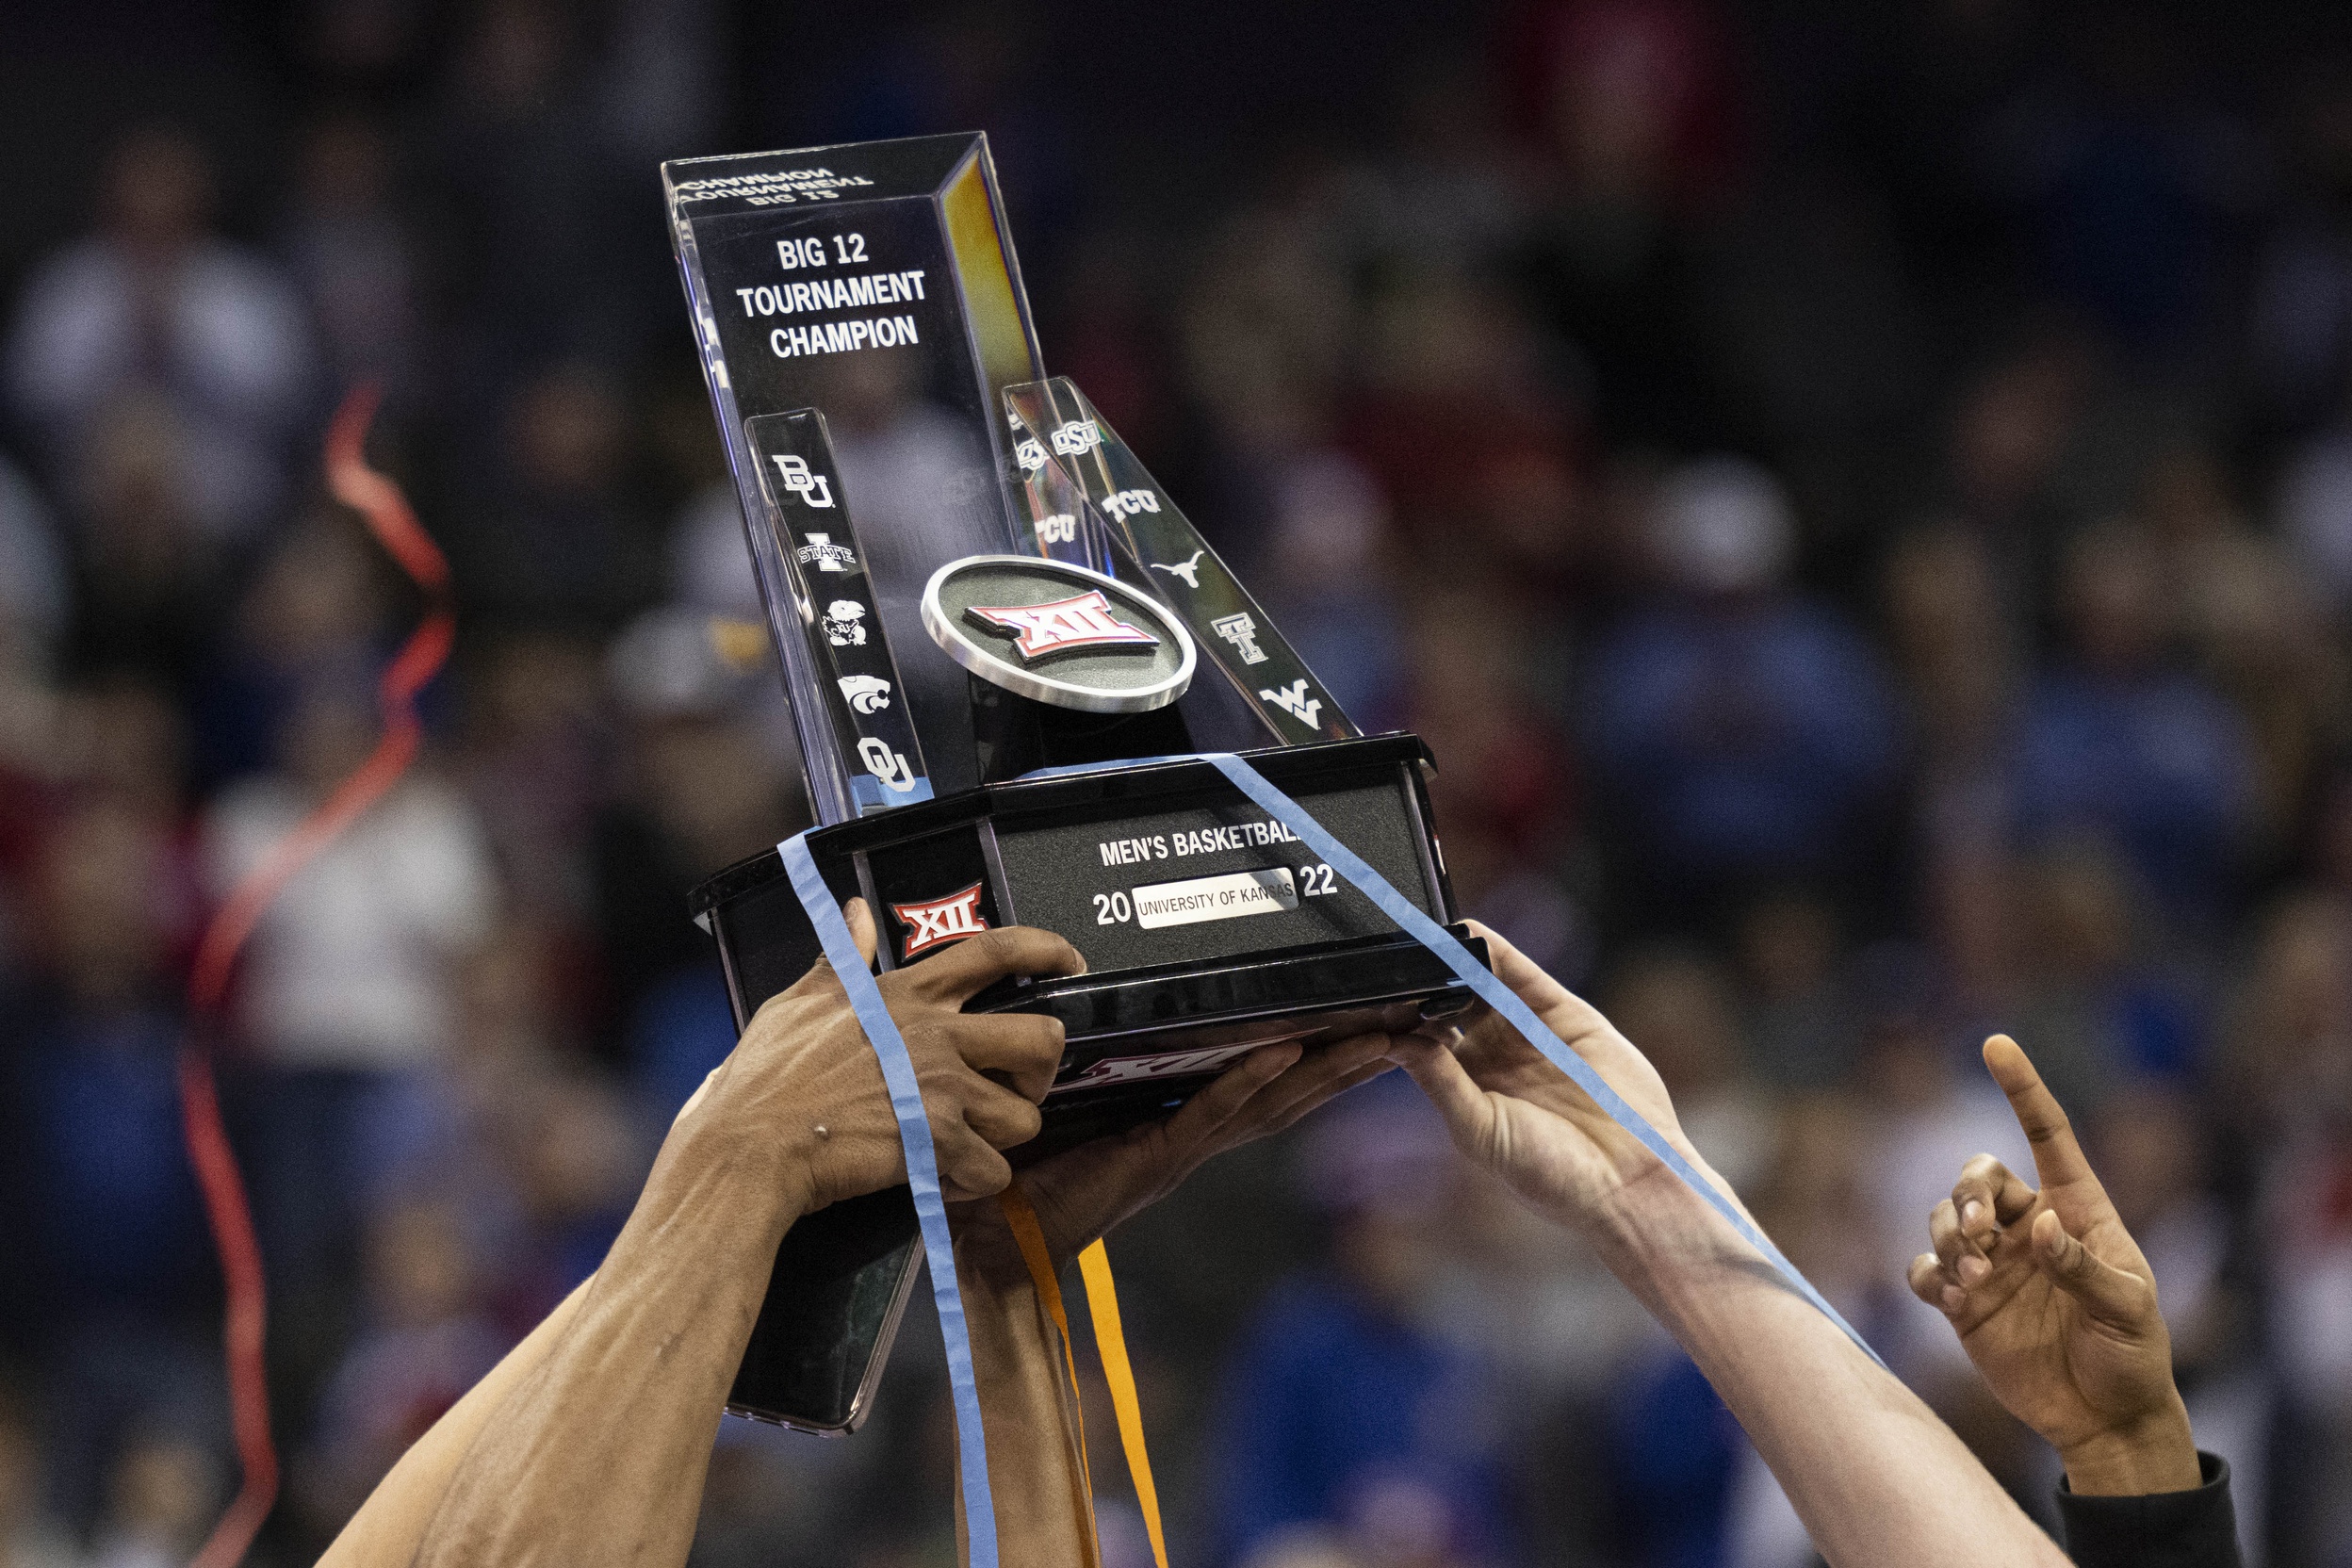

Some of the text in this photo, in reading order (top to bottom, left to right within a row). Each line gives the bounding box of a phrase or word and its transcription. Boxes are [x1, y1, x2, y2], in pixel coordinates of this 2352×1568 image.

[776, 233, 869, 270] BIG 12
[736, 270, 926, 318] TOURNAMENT
[770, 316, 919, 358] CHAMPION
[772, 454, 836, 509] BU
[1102, 489, 1161, 523] TCU
[858, 737, 916, 792] OU
[1100, 820, 1302, 866] MEN'S BASKETBAL
[1138, 882, 1294, 916] UNIVERSITY OF KANSAS
[1300, 863, 1338, 896] 22
[894, 882, 988, 958] XII
[1093, 891, 1131, 925] 20
